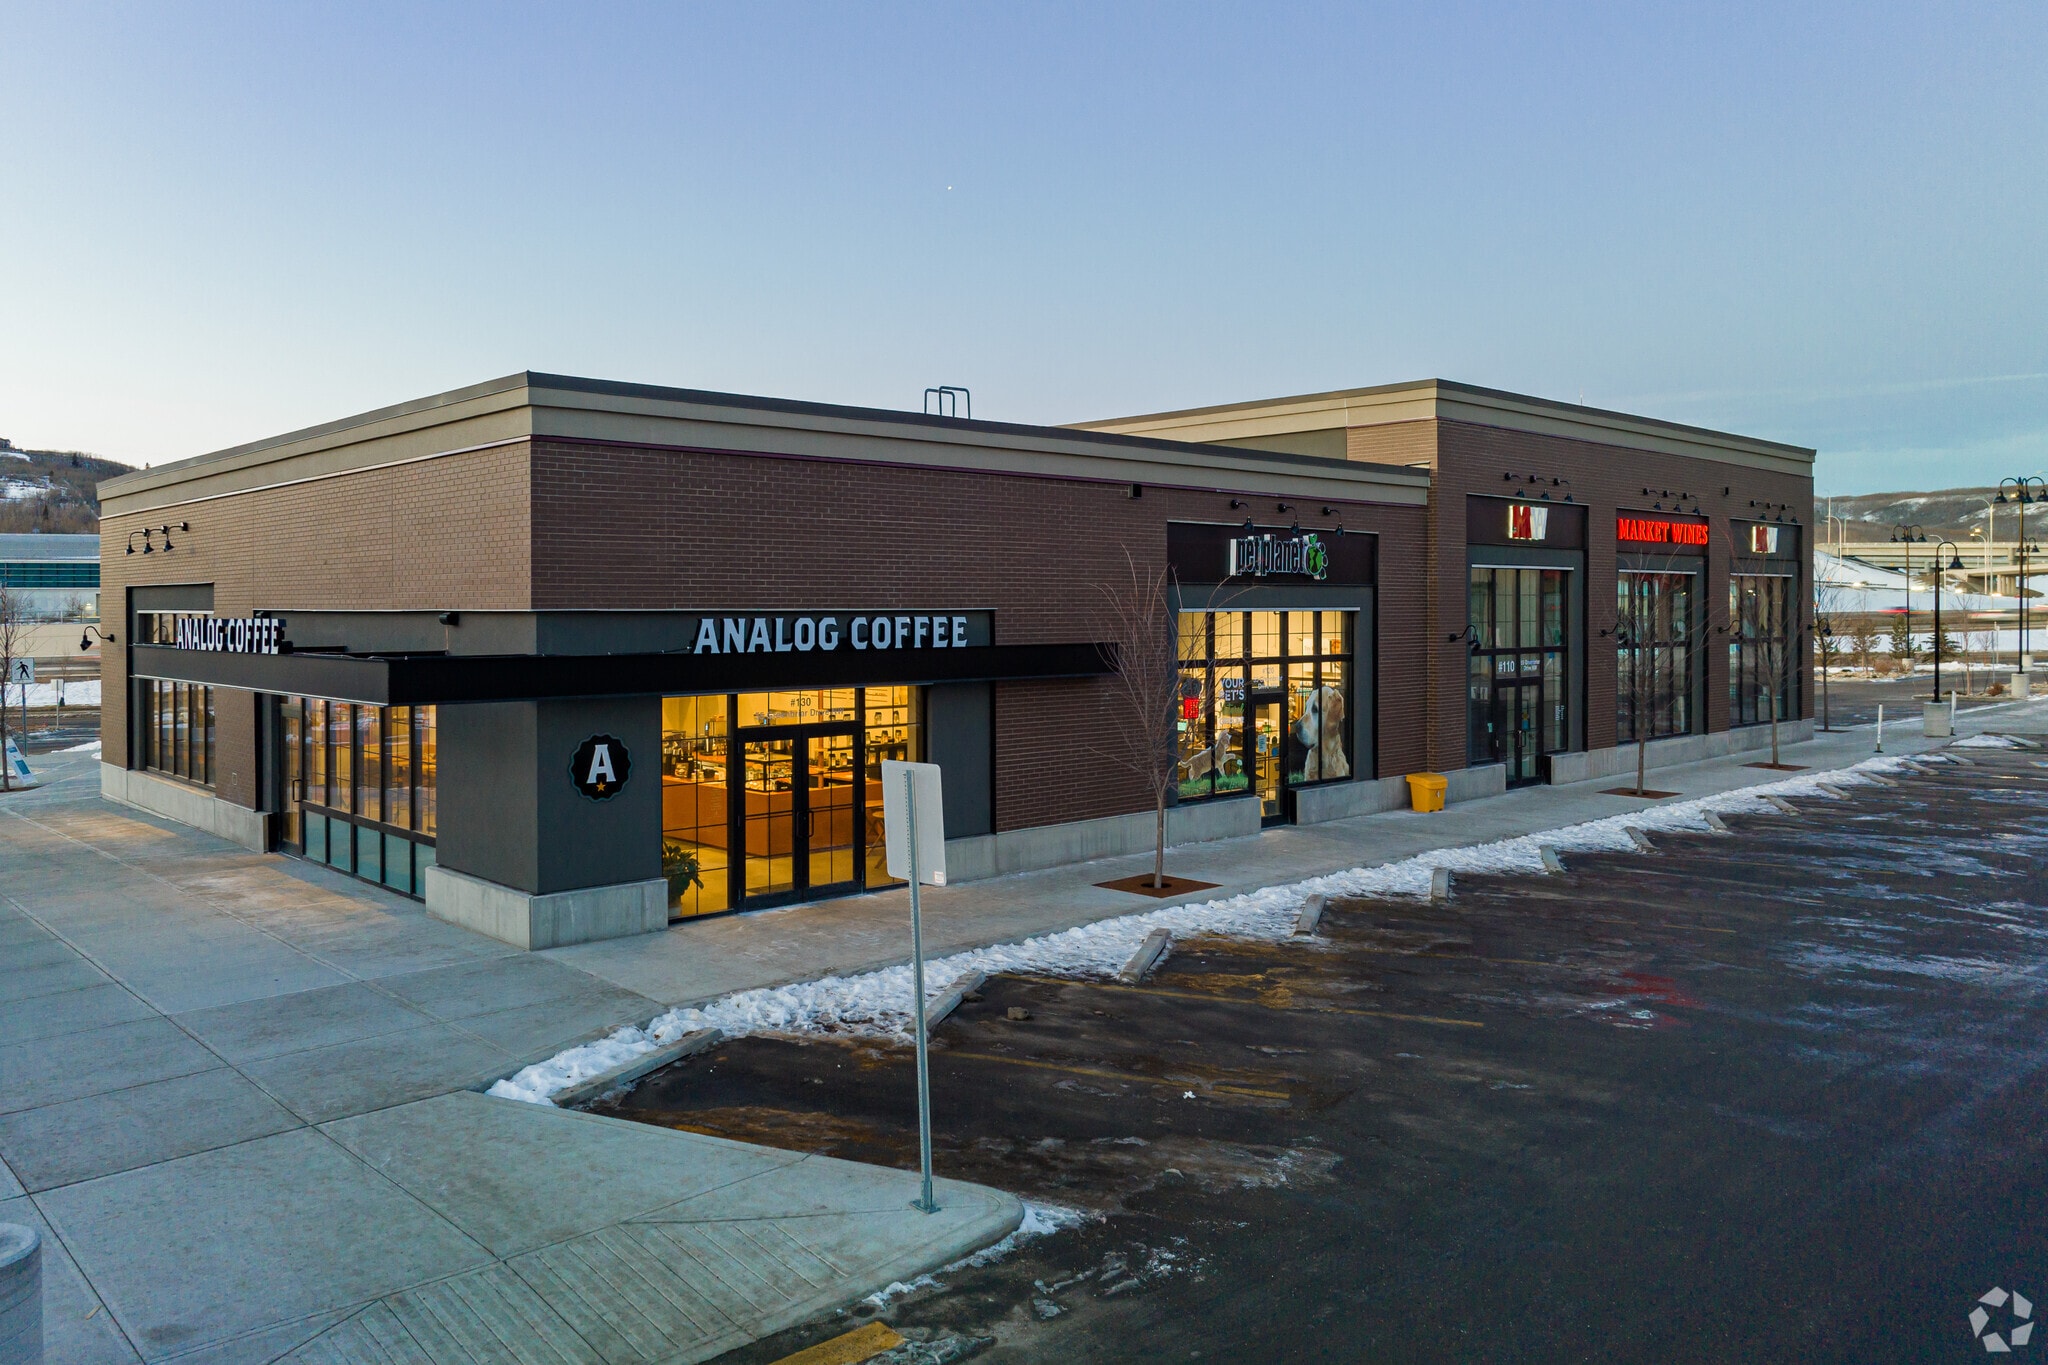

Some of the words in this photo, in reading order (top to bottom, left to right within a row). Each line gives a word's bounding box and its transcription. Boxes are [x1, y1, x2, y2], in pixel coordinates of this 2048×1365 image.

[1617, 518, 1669, 543] MARKET
[1671, 523, 1709, 545] WINES
[176, 618, 223, 652] ANALOG
[227, 618, 279, 655] COFFEE
[693, 616, 839, 654] ANALOG
[851, 616, 968, 650] COFFEE
[1498, 661, 1515, 672] #110
[1221, 678, 1244, 688] YOUR
[790, 697, 811, 707] #130
[1219, 689, 1245, 701] PET'S
[586, 744, 616, 784] A
